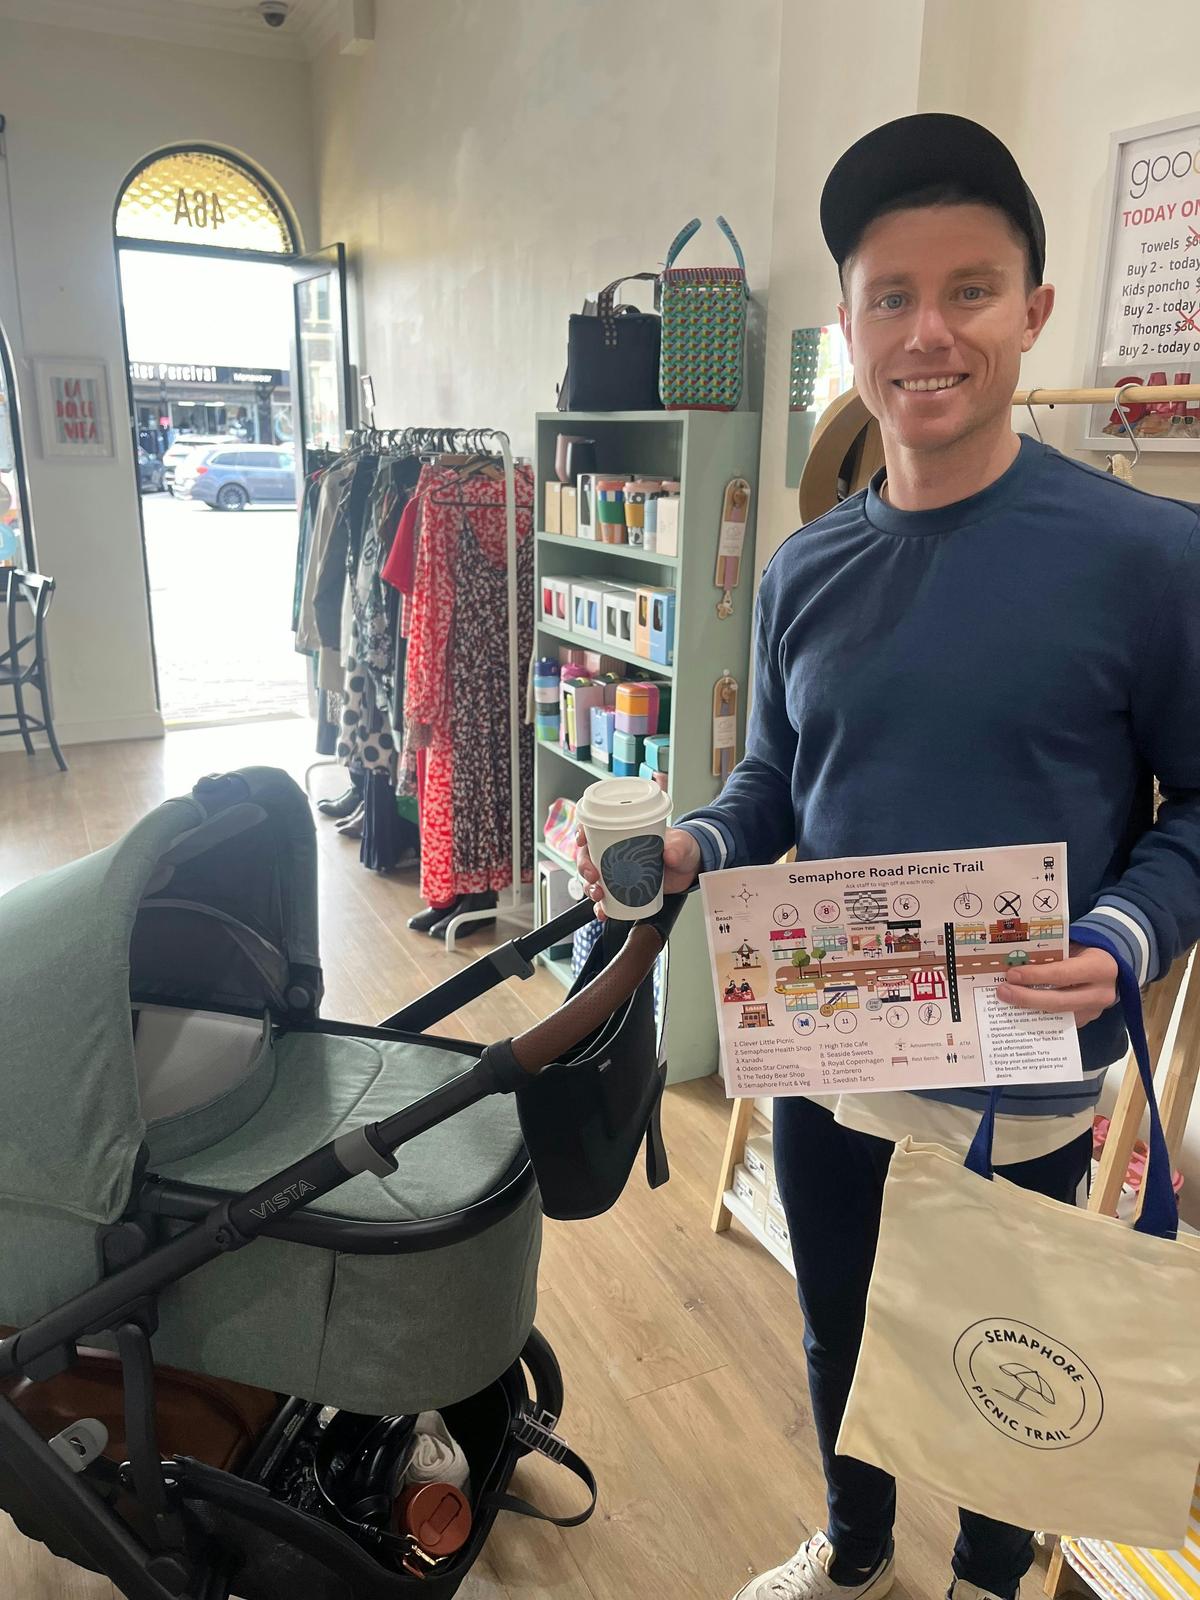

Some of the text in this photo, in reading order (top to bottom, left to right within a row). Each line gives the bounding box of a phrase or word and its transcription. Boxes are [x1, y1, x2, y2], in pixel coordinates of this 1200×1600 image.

[1122, 202, 1177, 228] TODAY
[1141, 237, 1179, 254] Towels
[1127, 264, 1148, 278] Buy
[1150, 261, 1157, 274] 2
[1169, 256, 1200, 271] today
[1122, 283, 1145, 297] Kids
[1147, 278, 1190, 297] poncho
[1123, 304, 1145, 319] Buy
[1146, 302, 1154, 314] 2
[1163, 299, 1196, 314] today
[1132, 322, 1172, 337] Thongs
[1119, 344, 1140, 359] Buy
[1141, 343, 1149, 355] 2
[1157, 340, 1191, 356] today
[158, 363, 218, 382] Percival
[788, 860, 985, 885] Semaphore Road Picnic Trail
[965, 902, 971, 910] 5
[740, 1047, 774, 1056] Semaphore
[743, 1081, 778, 1089] Semaphore
[754, 1073, 773, 1081] Teddy
[249, 1179, 317, 1220] VISTA
[984, 1329, 1085, 1383] SEMAPHORE
[972, 1384, 1071, 1441] PICNIC TRAIL
